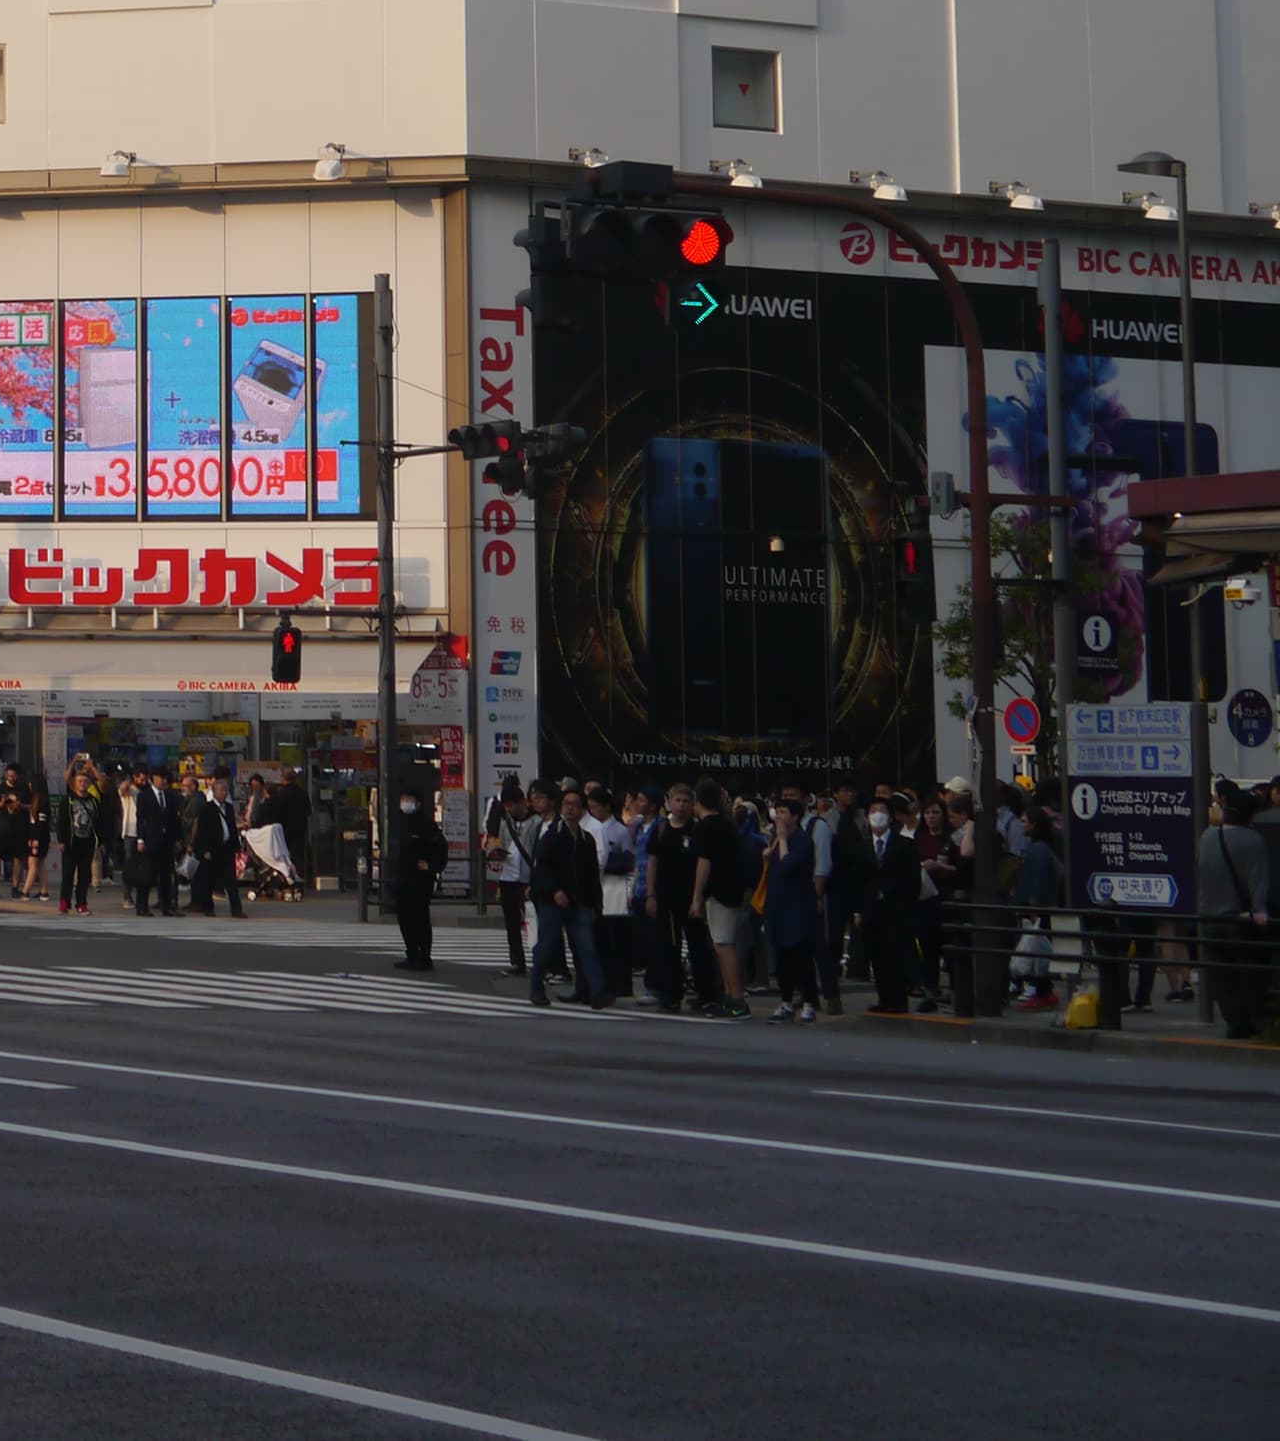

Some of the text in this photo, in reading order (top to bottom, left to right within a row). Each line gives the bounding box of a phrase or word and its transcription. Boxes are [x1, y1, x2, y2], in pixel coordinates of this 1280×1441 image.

[1078, 246, 1122, 275] BIC
[724, 292, 813, 321] UAWEI
[1091, 318, 1184, 345] HUAWEI
[479, 306, 525, 415] Tax
[241, 429, 280, 444] 4.5kg
[8, 547, 379, 606] ビックカメラ
[724, 565, 827, 589] ULTIMATE
[725, 589, 827, 606] PERFORMANCE
[487, 616, 527, 634] 免税
[189, 680, 298, 691] BIC CAMERA AKIBA
[1099, 790, 1187, 805] 千代田区エリアマップ
[1100, 804, 1192, 818] Chiyoda City Area Map
[1118, 878, 1164, 894] 中央通り
